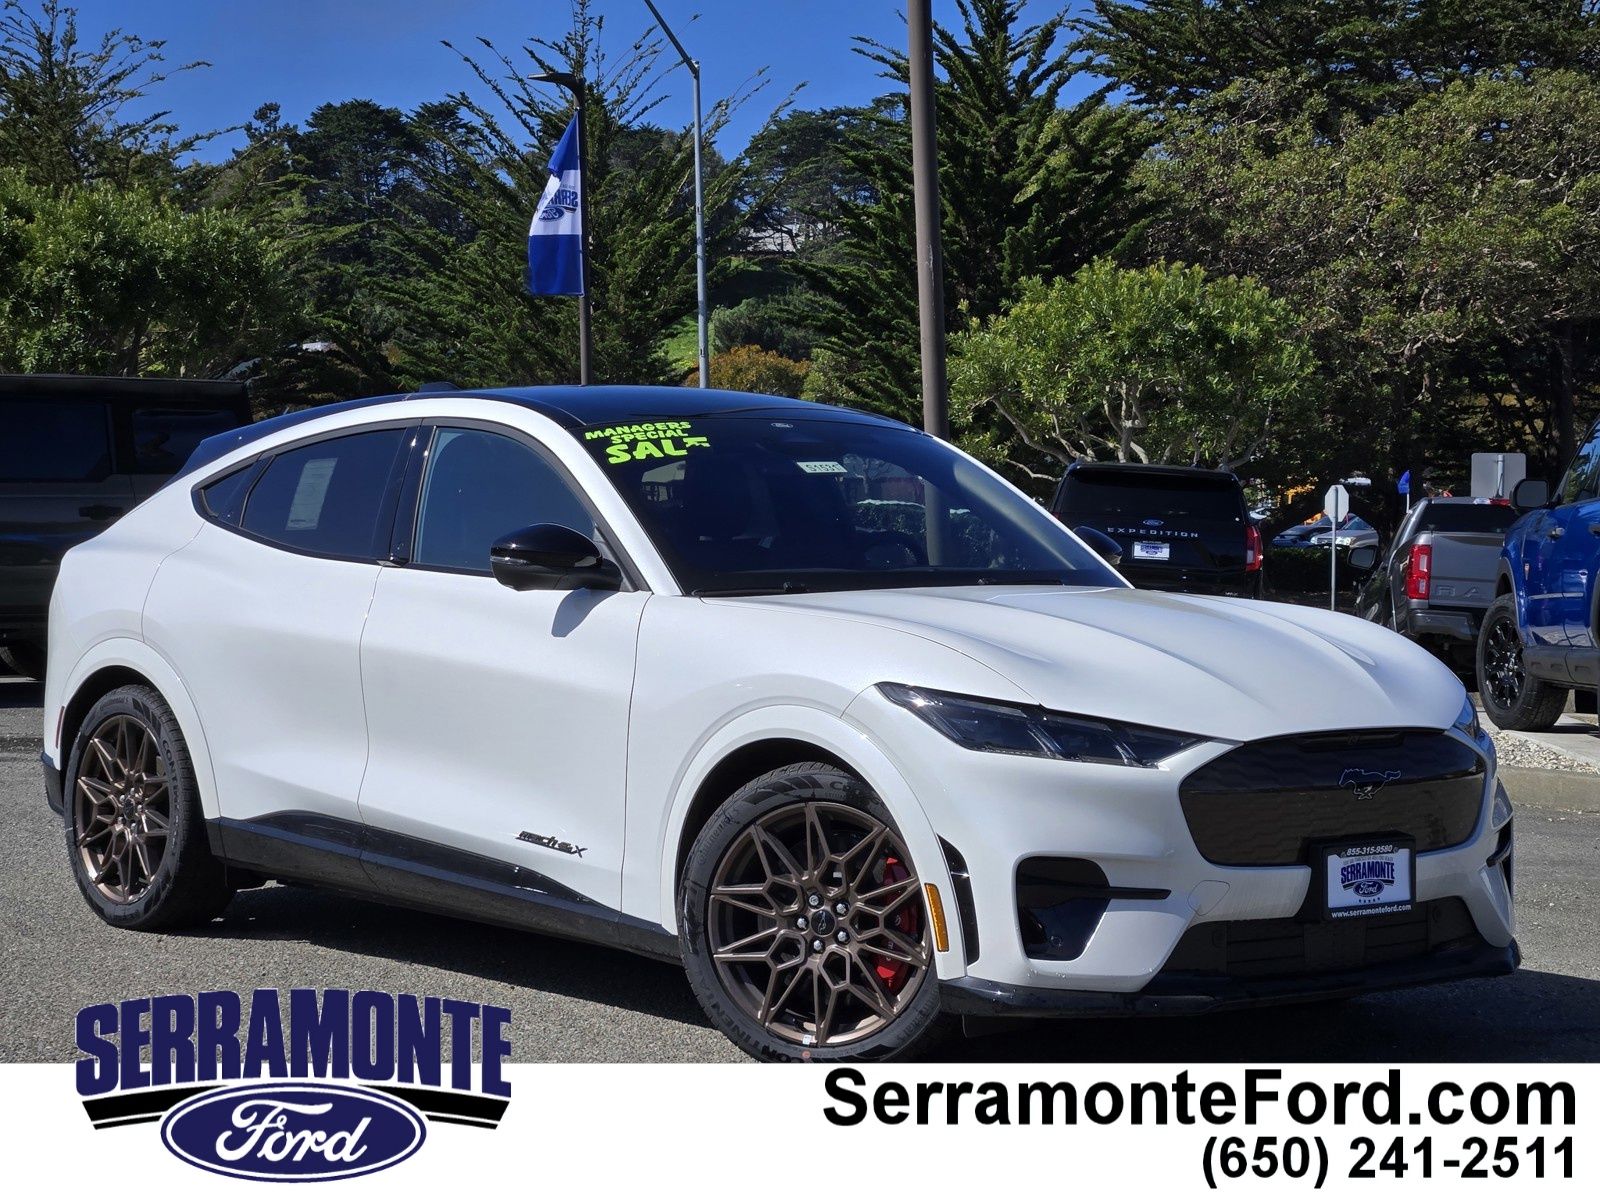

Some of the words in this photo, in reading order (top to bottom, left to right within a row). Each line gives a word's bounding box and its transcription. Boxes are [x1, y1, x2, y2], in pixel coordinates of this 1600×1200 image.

[585, 421, 691, 440] MANAGERS
[610, 429, 688, 444] SPECIAL
[1107, 527, 1198, 537] EXPEDITION
[1346, 845, 1393, 856] 855-315-9580
[1340, 861, 1395, 885] SERRAMONTE
[1358, 881, 1379, 894] Ford
[1331, 904, 1412, 918] www.serramonteford.com
